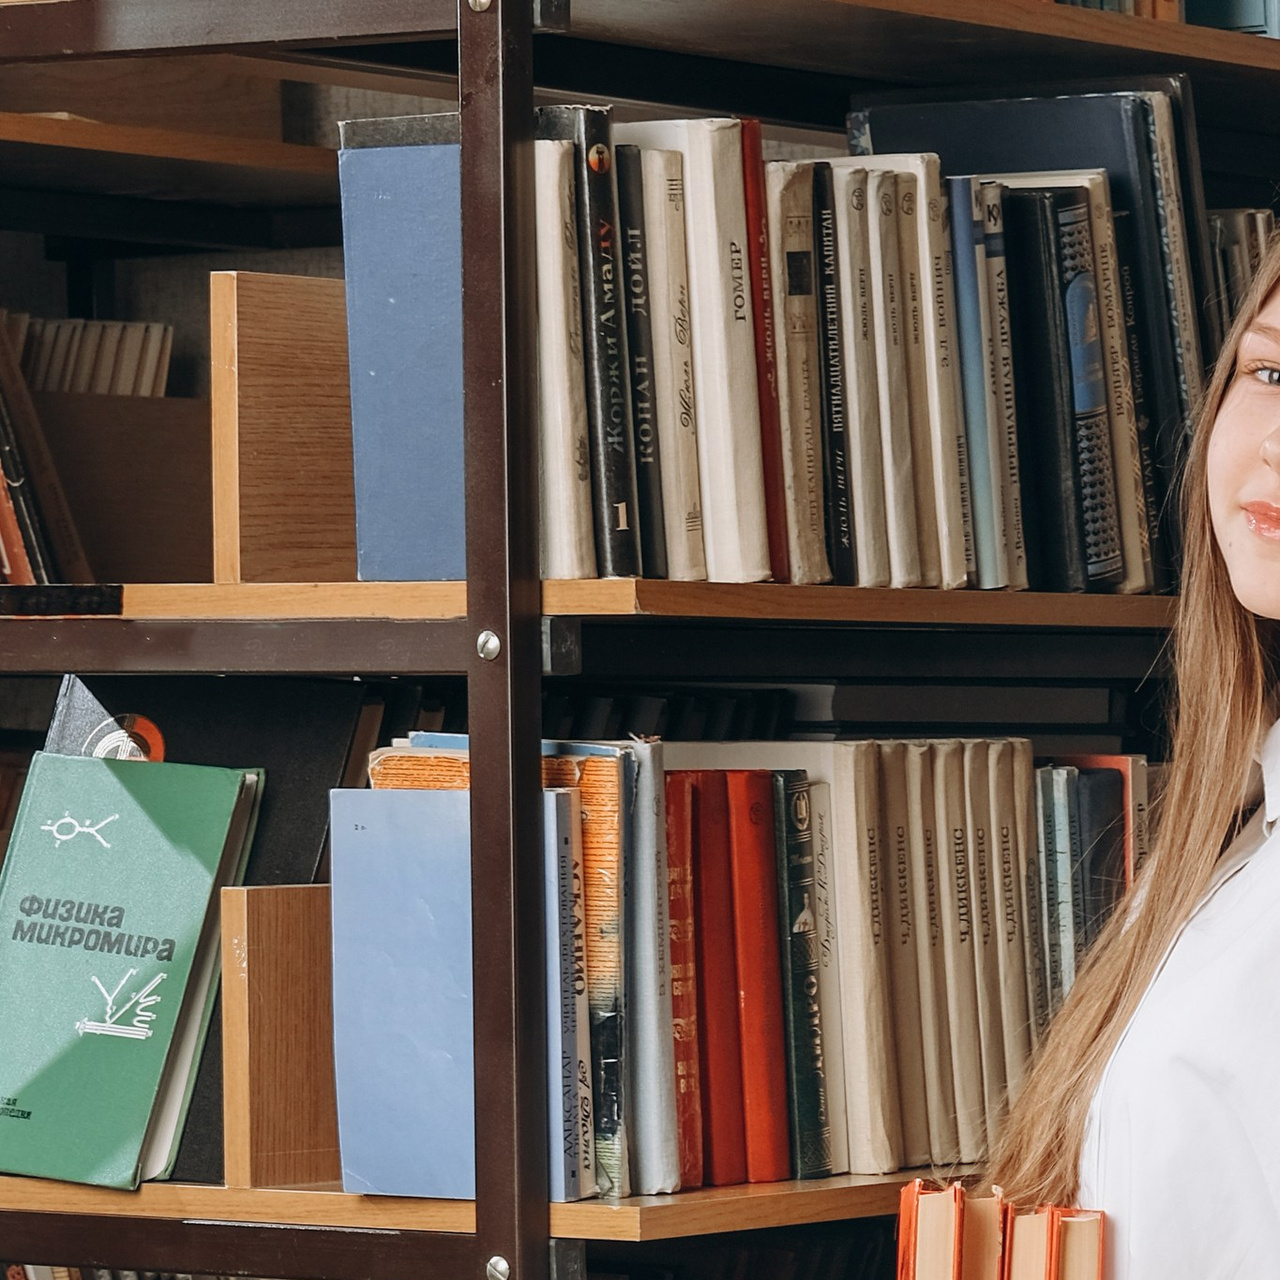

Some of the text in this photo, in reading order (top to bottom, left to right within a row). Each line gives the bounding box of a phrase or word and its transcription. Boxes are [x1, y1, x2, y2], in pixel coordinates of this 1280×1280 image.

[729, 241, 748, 322] ГОМЕР
[822, 209, 845, 432] ПЯТНАДЦАТИЛЕТНИЙ КАПИТАН
[933, 255, 947, 328] ВОЙНИЧ
[995, 269, 1010, 349] ДРУЖБА
[626, 225, 656, 464] КОНАН ДОЙЛ
[1109, 344, 1126, 417] ВОЛЬТЕР
[613, 502, 629, 531] 1
